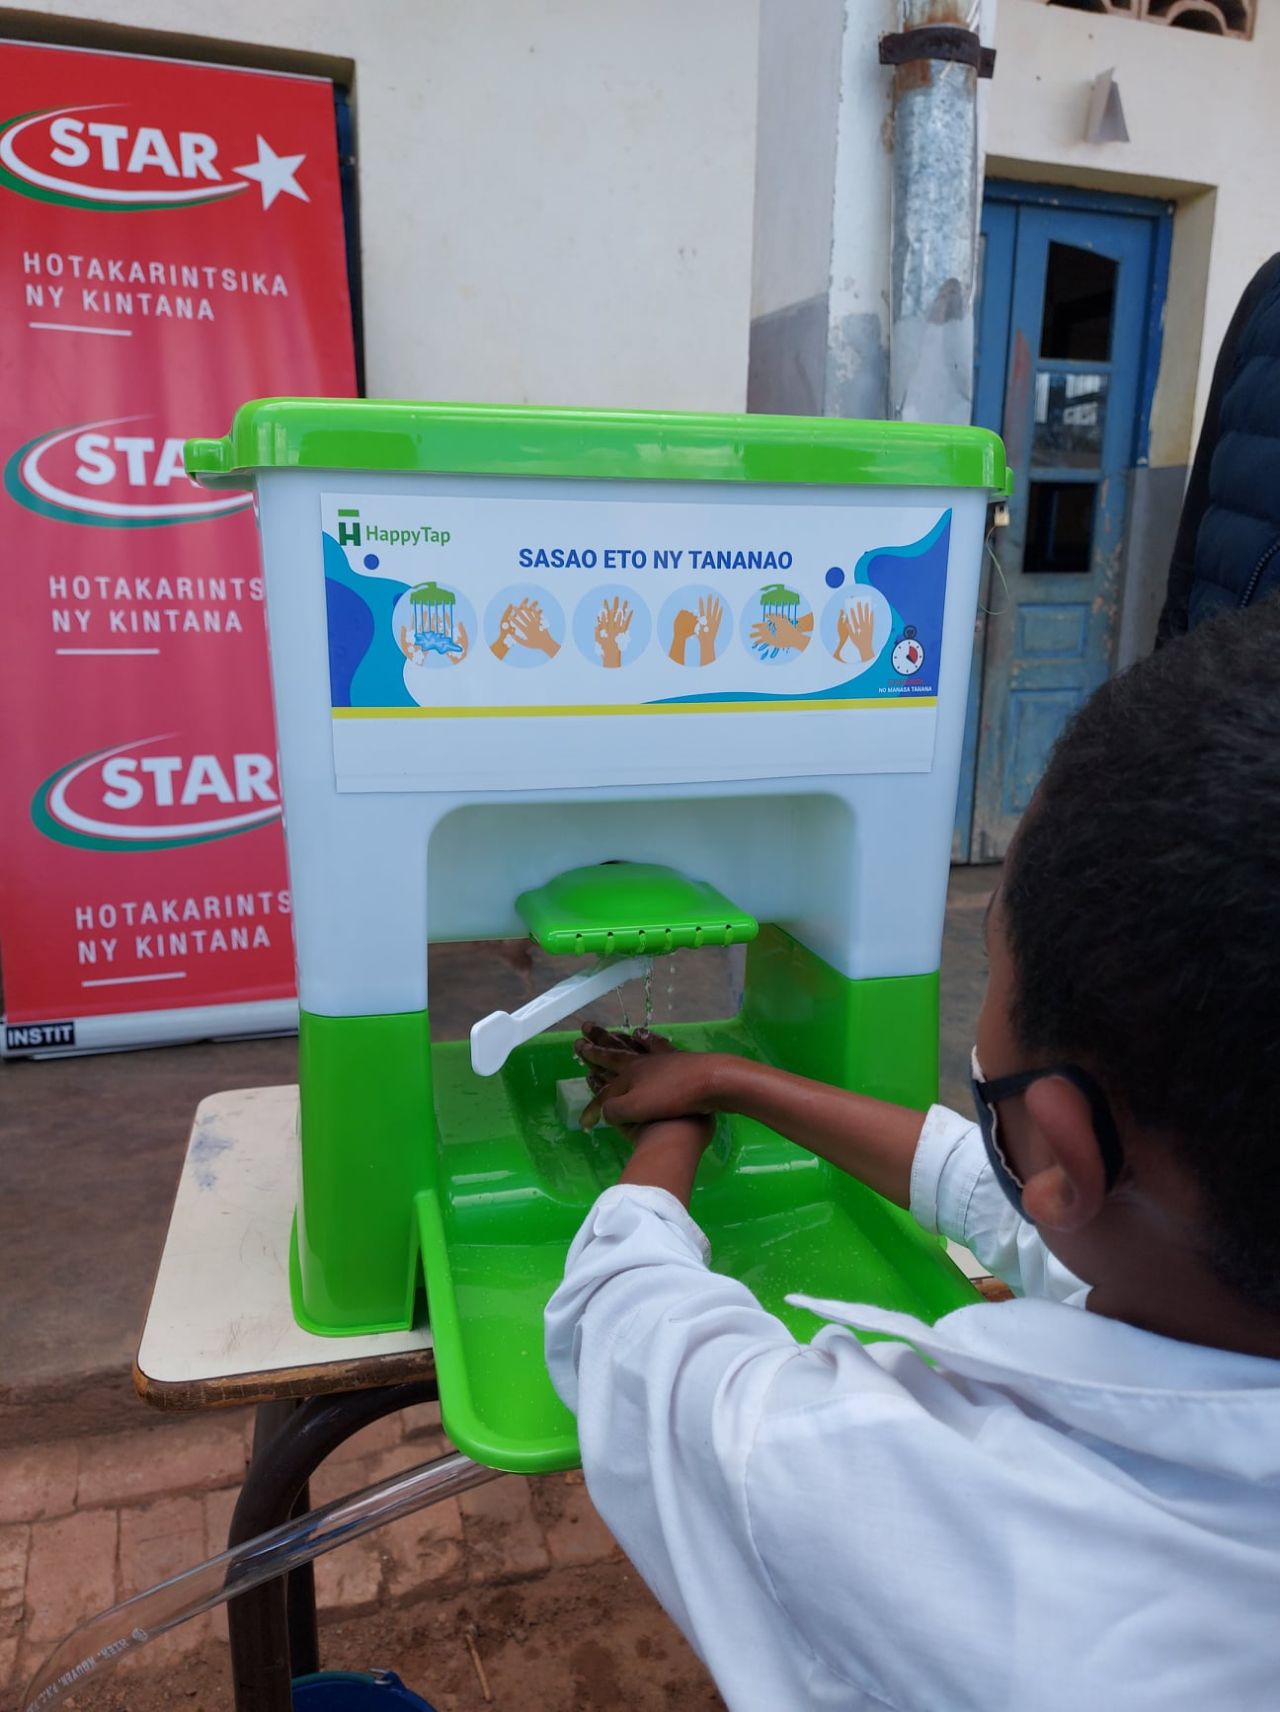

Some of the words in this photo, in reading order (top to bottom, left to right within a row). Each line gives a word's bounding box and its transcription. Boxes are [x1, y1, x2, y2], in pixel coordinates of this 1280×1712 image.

[49, 118, 222, 180] STAR
[23, 251, 288, 296] HOTAKARINTSIKA
[26, 284, 64, 308] NY
[83, 290, 215, 321] KINTANA
[366, 525, 451, 546] HappyTap
[519, 548, 597, 569] SASAO
[603, 549, 647, 569] ETO
[653, 550, 684, 569] NY
[688, 550, 793, 570] TANANAO
[52, 609, 91, 633] NY
[109, 609, 243, 633] KINTANA
[101, 753, 278, 810] STAR
[77, 938, 117, 964] NY
[135, 925, 271, 959] KINTANA
